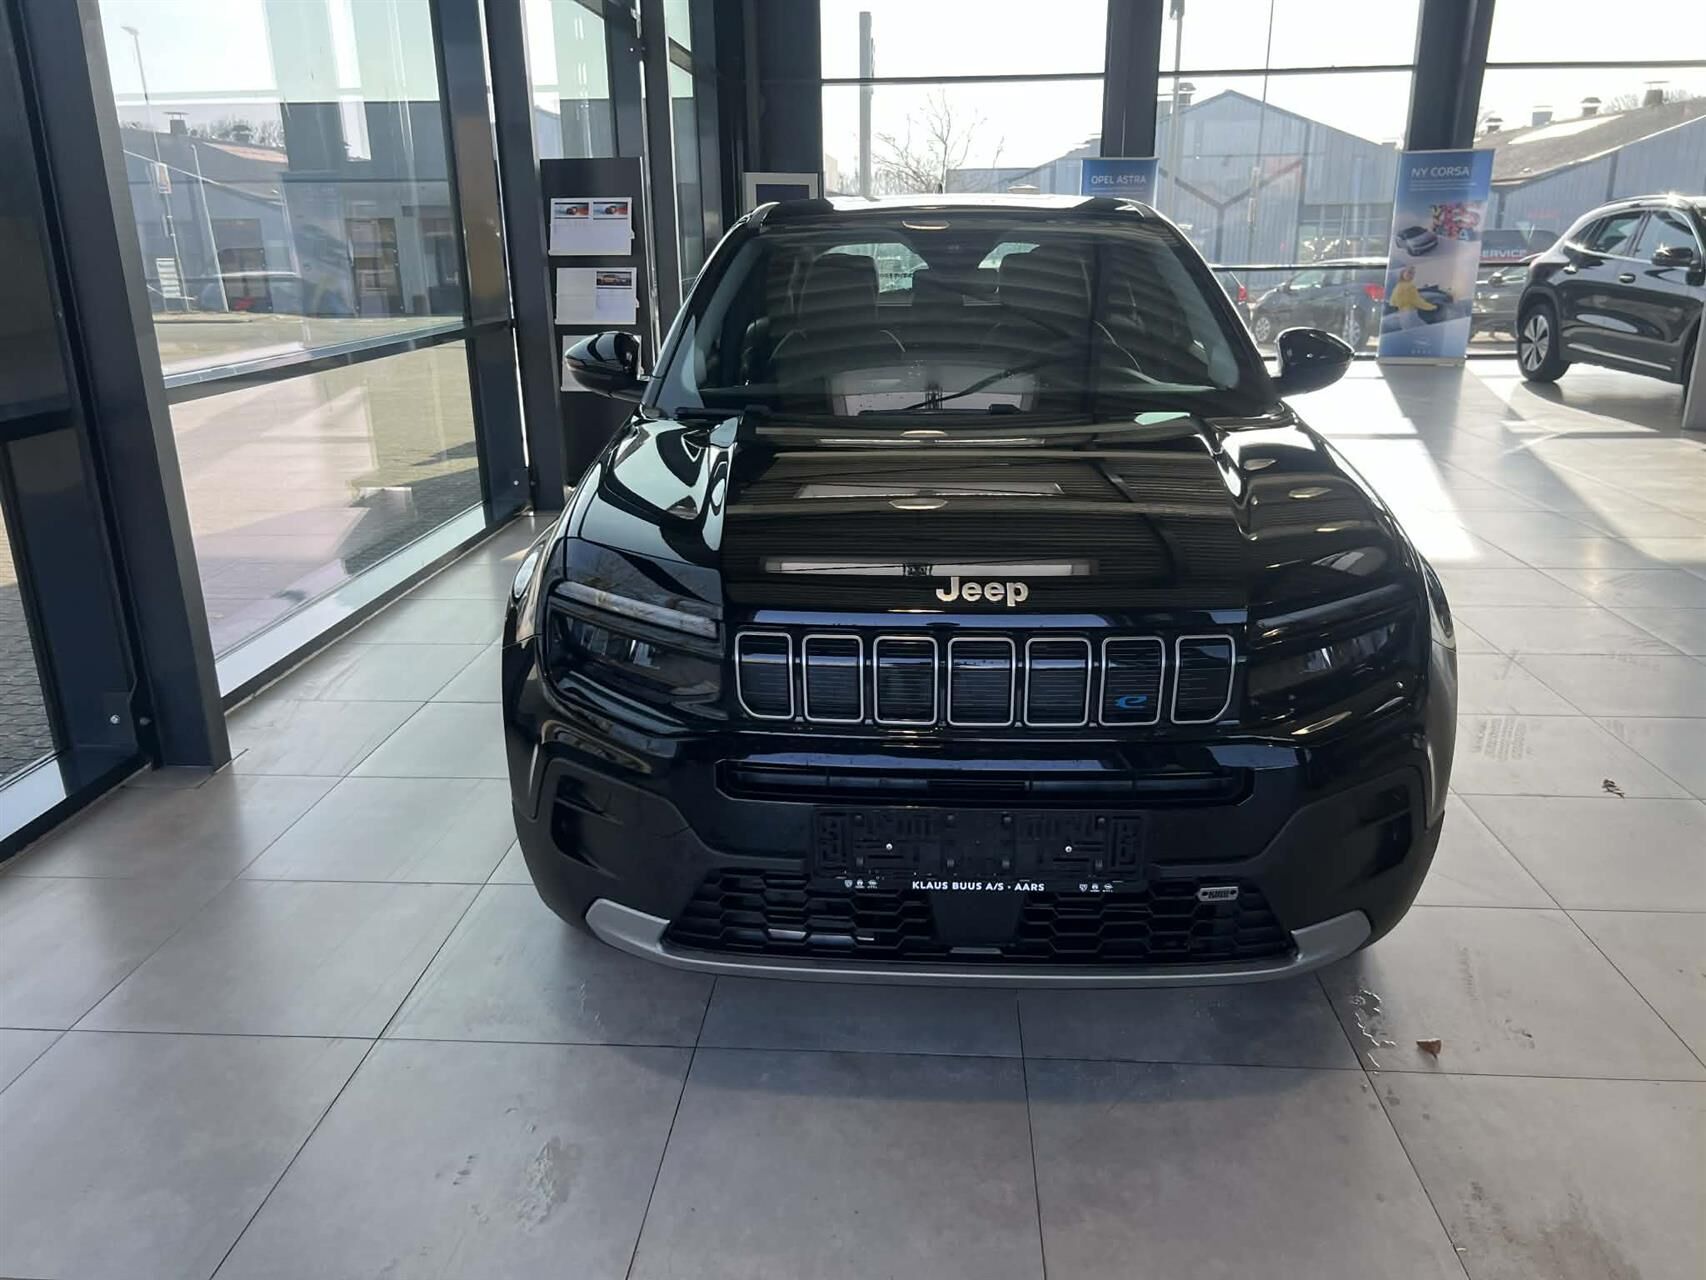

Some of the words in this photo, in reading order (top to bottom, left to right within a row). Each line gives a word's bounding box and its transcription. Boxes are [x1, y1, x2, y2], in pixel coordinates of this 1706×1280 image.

[1411, 167, 1429, 177] NY
[1430, 166, 1470, 177] CORSA
[1091, 175, 1114, 185] OPEL
[1116, 175, 1147, 185] ASTRA
[1482, 249, 1527, 258] ERVICE
[935, 576, 1029, 607] Jeep
[912, 880, 948, 890] KLAUS
[952, 881, 982, 891] BUUS
[985, 882, 1004, 891] A/S
[1014, 882, 1045, 892] AARS
